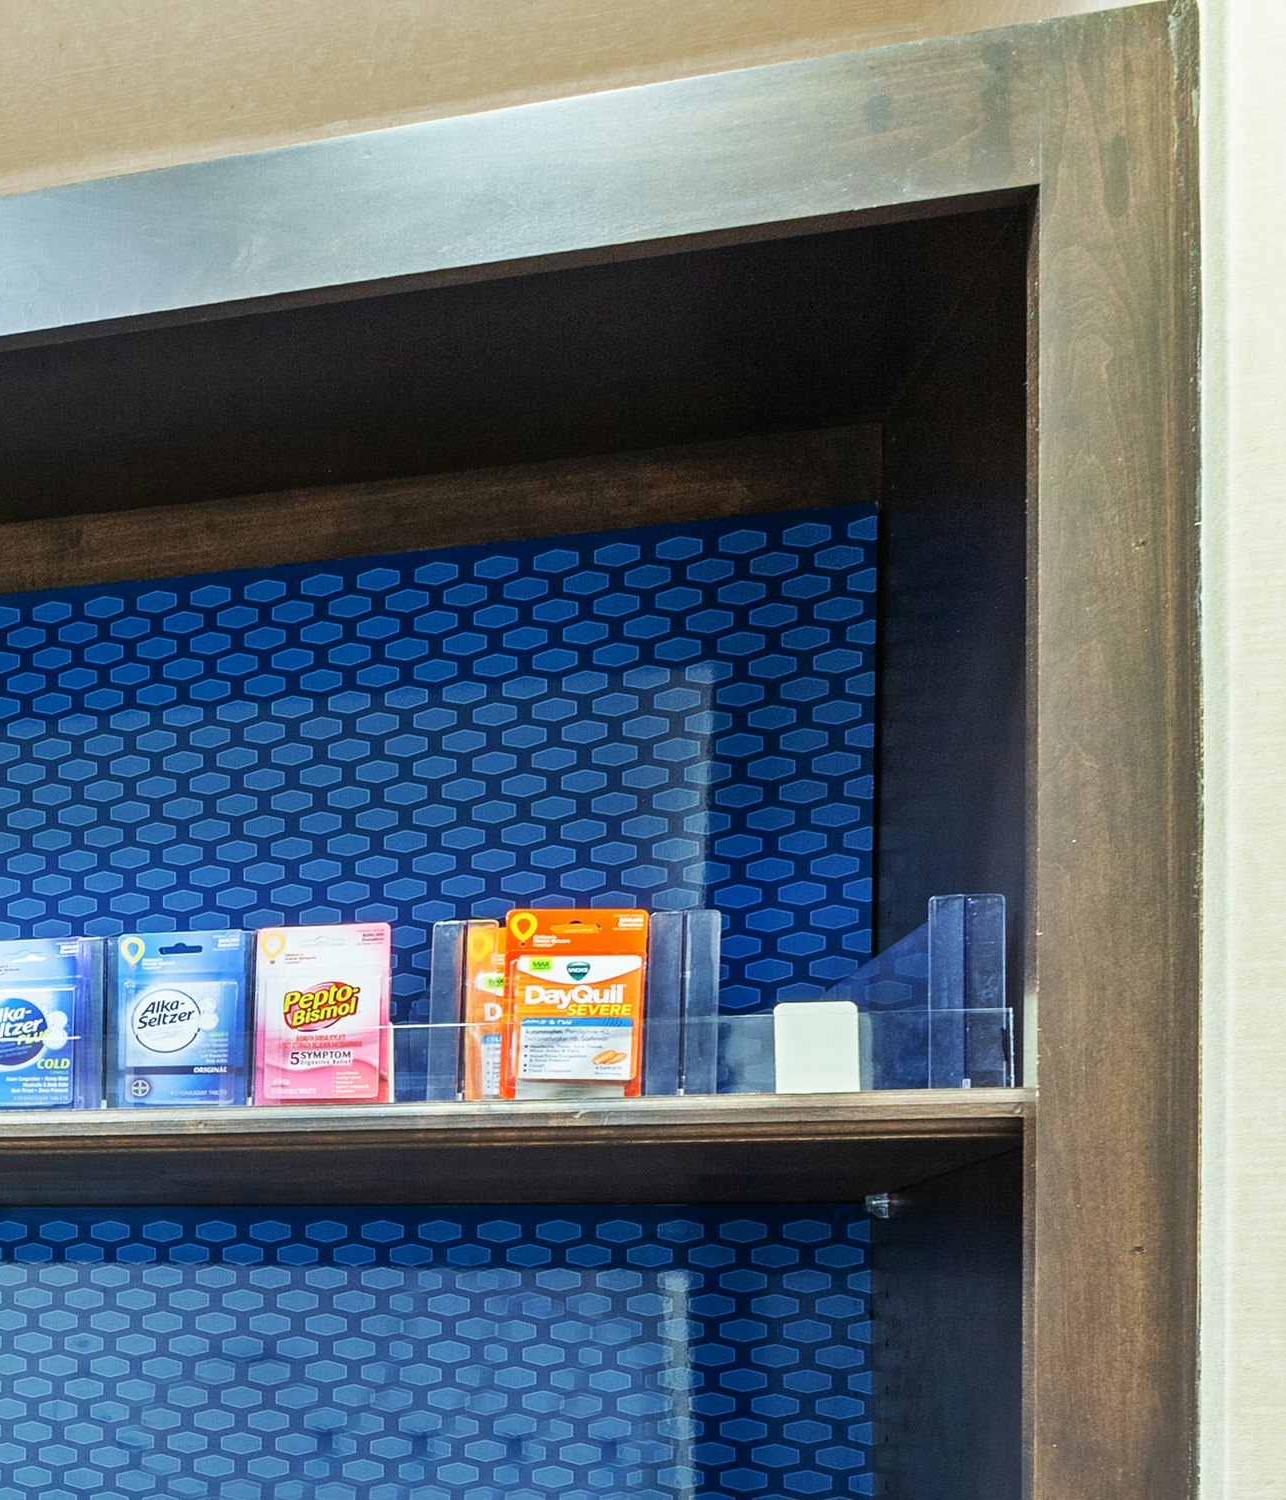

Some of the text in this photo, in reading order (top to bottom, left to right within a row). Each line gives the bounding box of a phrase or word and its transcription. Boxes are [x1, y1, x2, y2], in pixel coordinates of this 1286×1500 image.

[532, 960, 551, 968] MAX
[283, 983, 360, 1012] Pepto-
[524, 983, 624, 1010] DayQuil
[141, 999, 185, 1015] Alka-
[292, 997, 358, 1027] Bismol
[567, 1003, 633, 1016] SEVERE
[137, 1007, 196, 1030] Seltzer
[36, 1058, 70, 1070] COLD
[290, 1050, 351, 1066] 5 SYMPTOM
[193, 1066, 227, 1074] ORIGINAL
